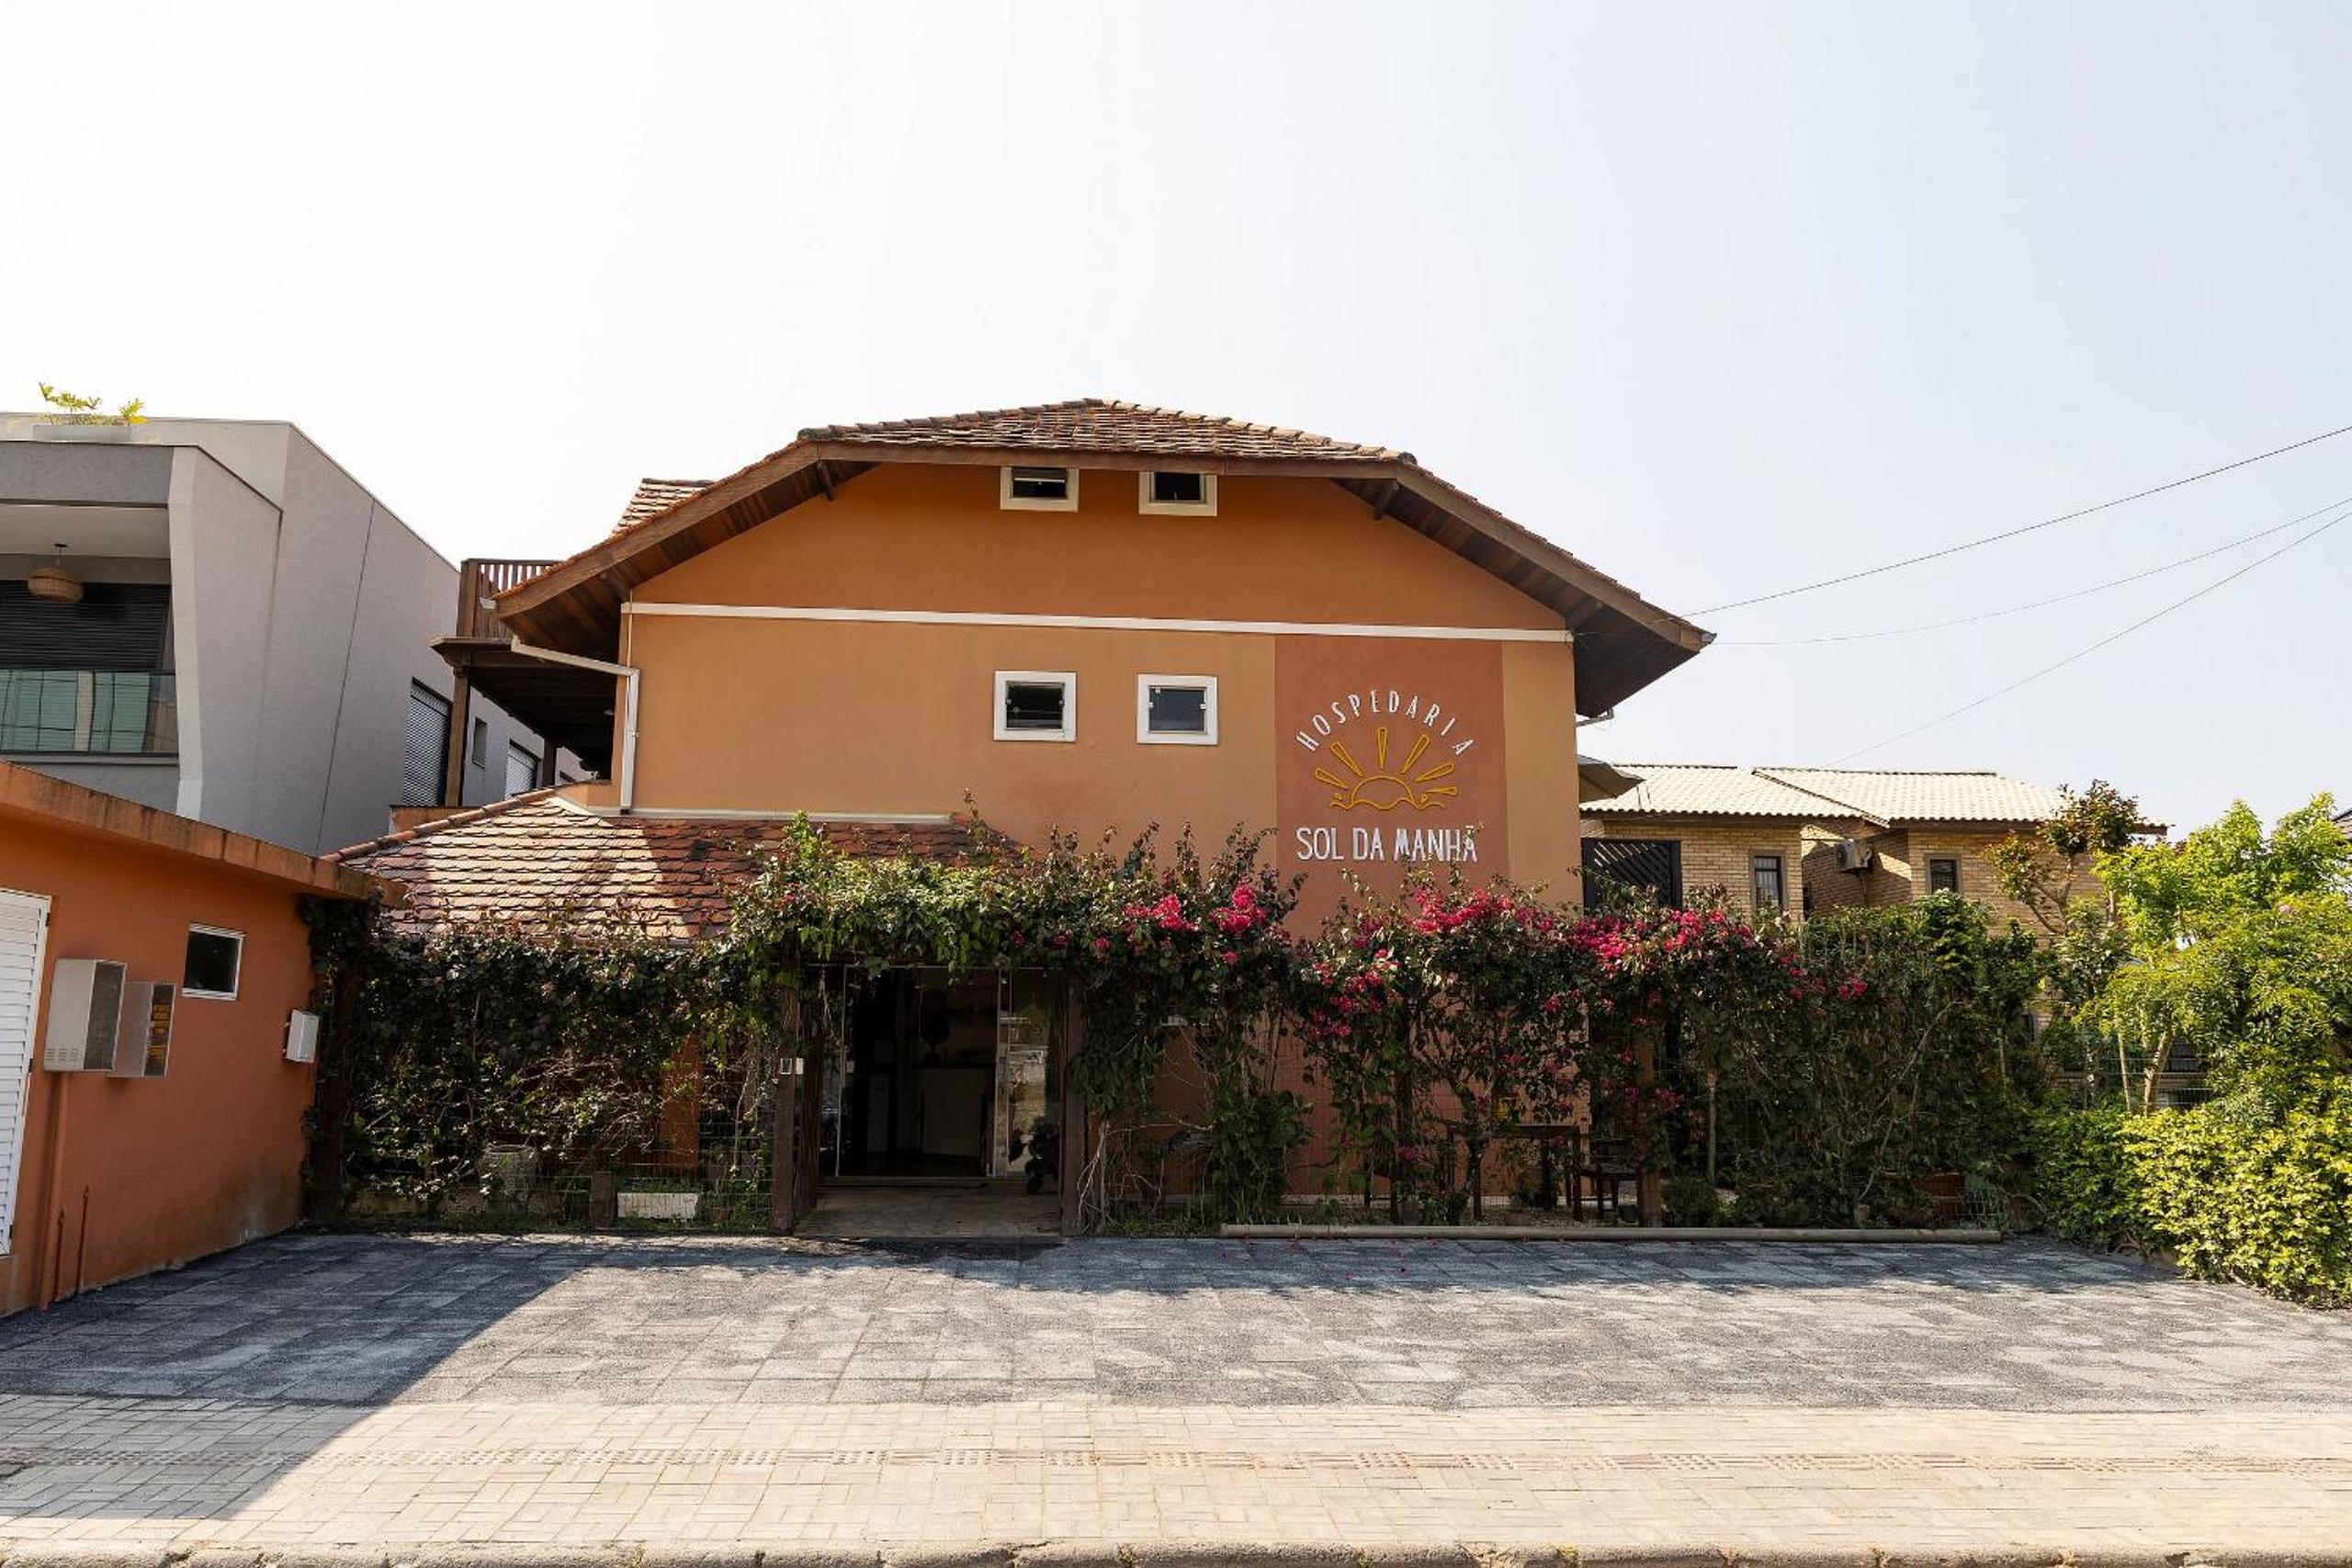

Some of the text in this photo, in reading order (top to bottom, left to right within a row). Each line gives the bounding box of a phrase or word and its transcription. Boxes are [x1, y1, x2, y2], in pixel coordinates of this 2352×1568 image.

[1295, 690, 1475, 755] HOSPEDARIA
[1295, 825, 1478, 863] SOL DA MANHÃ
